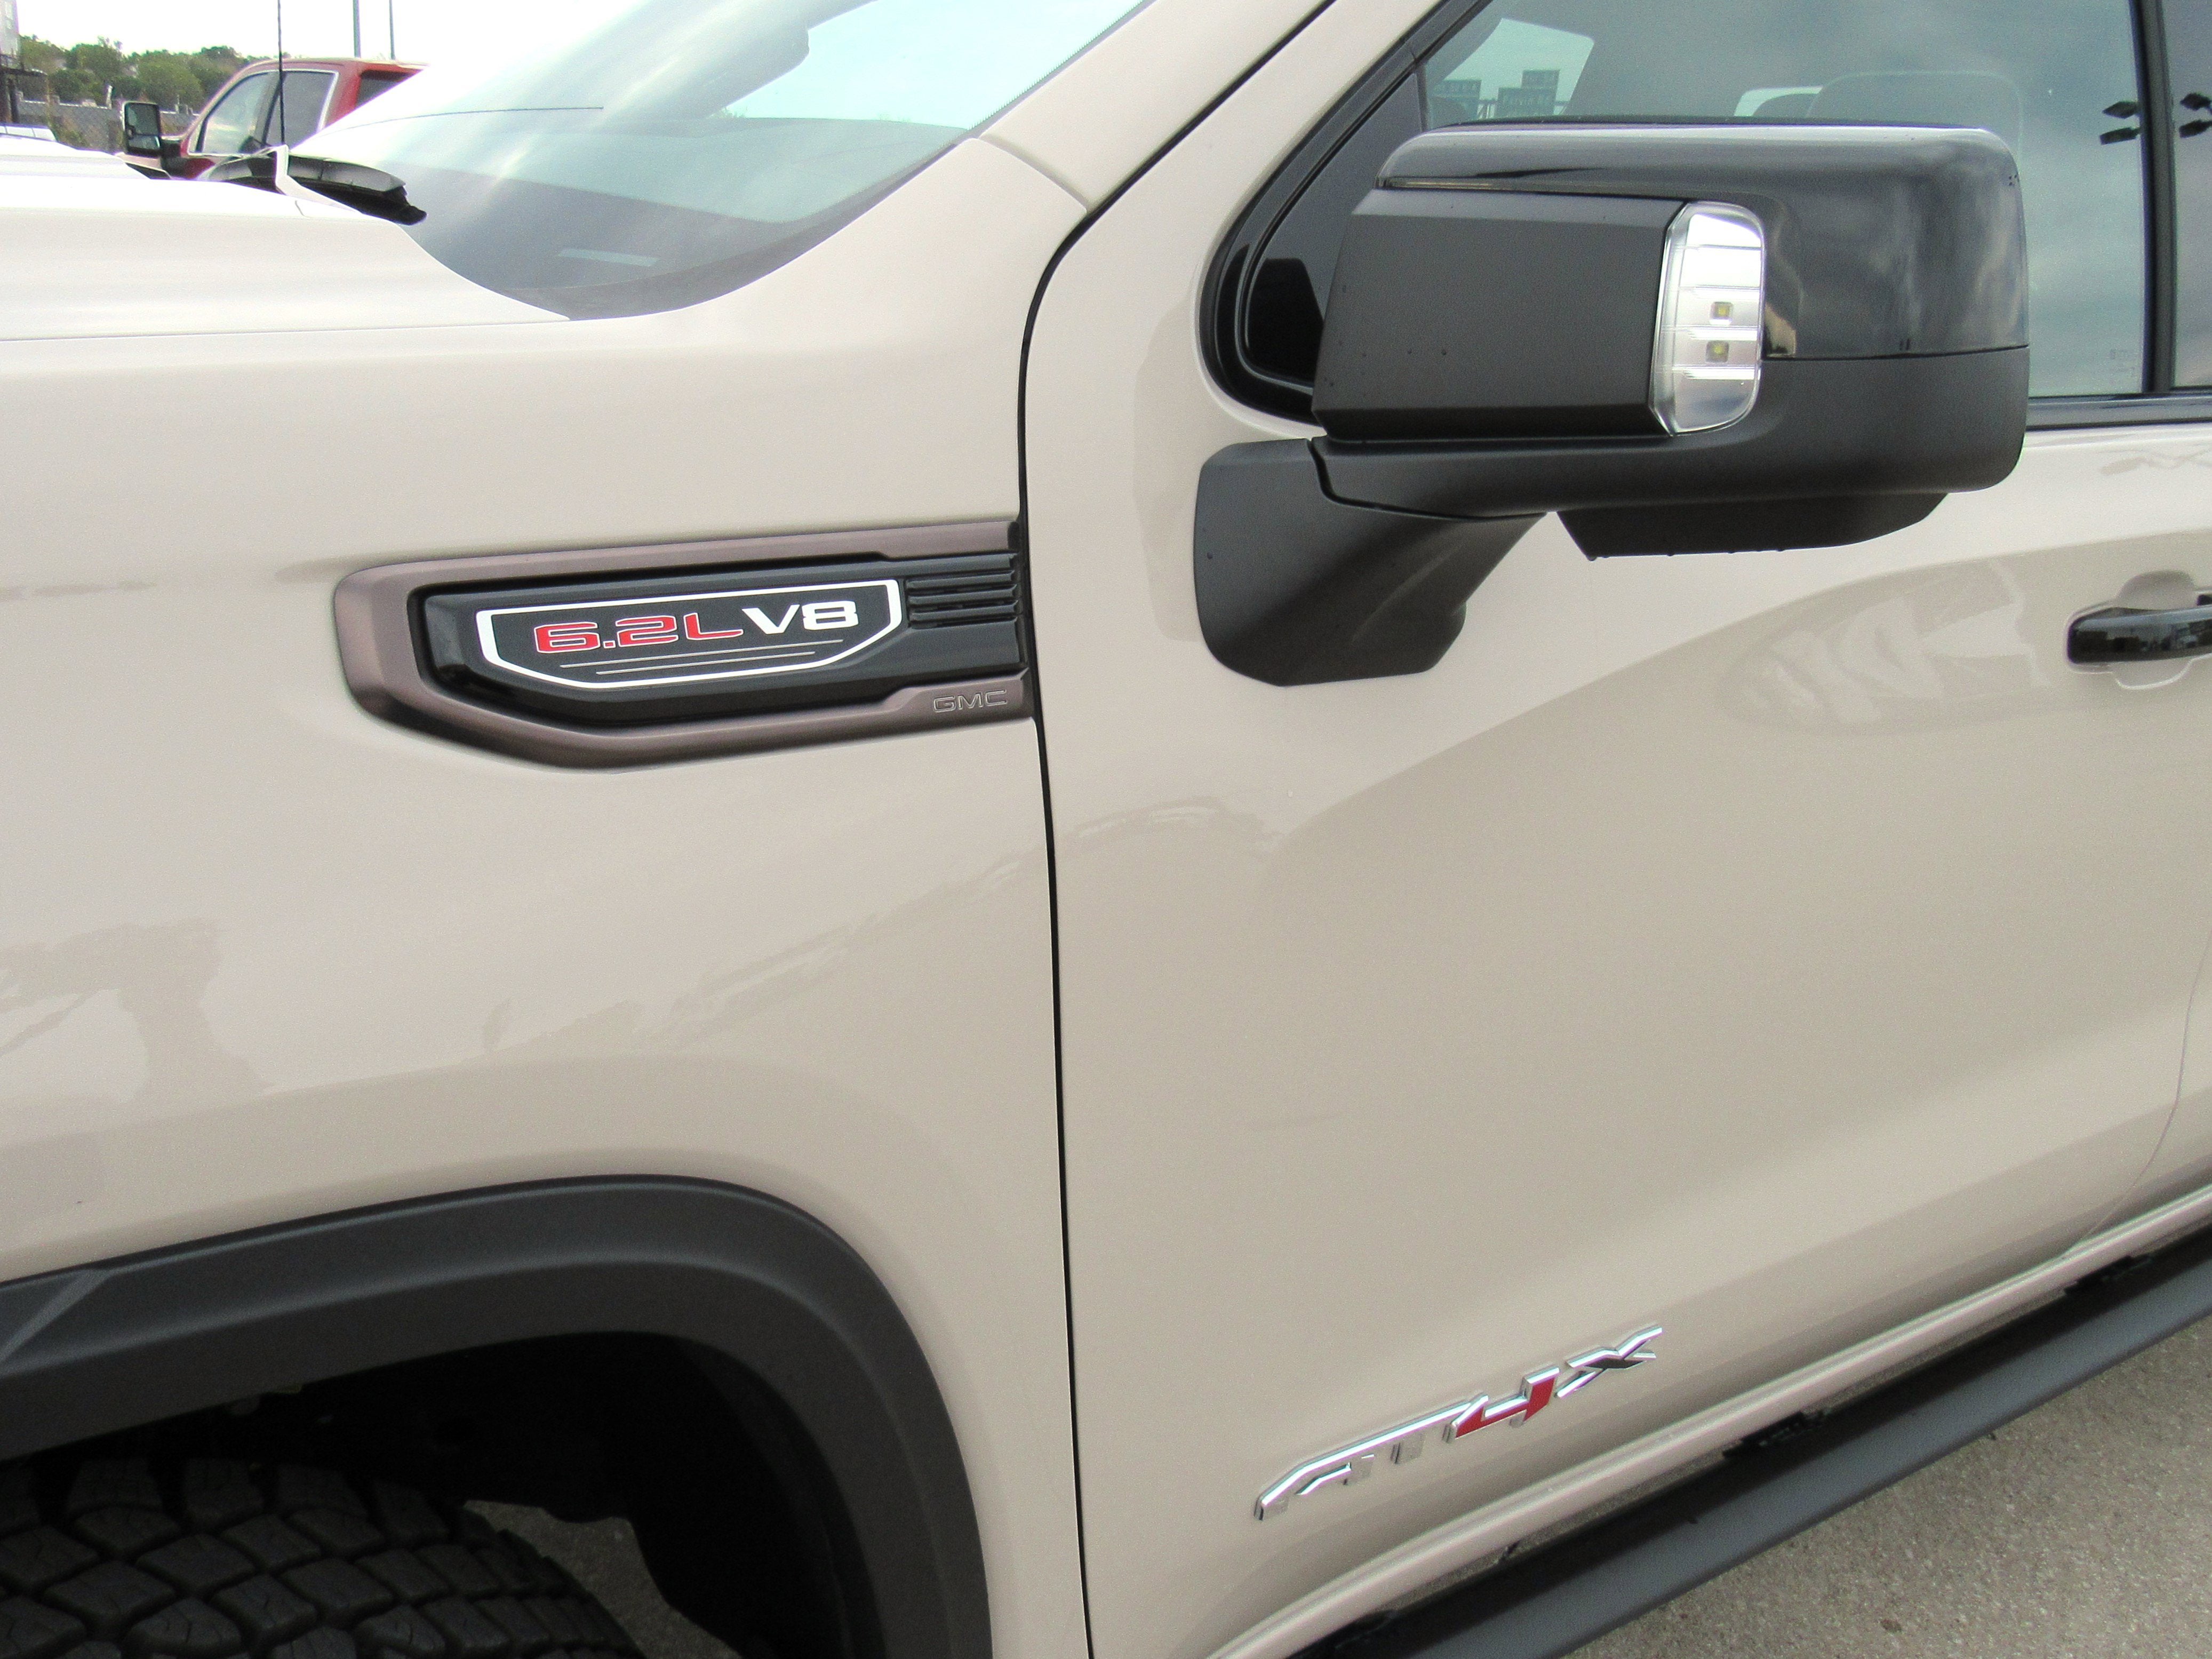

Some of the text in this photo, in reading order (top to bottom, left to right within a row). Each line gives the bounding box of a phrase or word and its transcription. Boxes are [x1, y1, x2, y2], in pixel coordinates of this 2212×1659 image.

[534, 601, 858, 653] 6.2L V8
[933, 689, 1008, 713] GMC
[1255, 1326, 1663, 1520] AT4X
